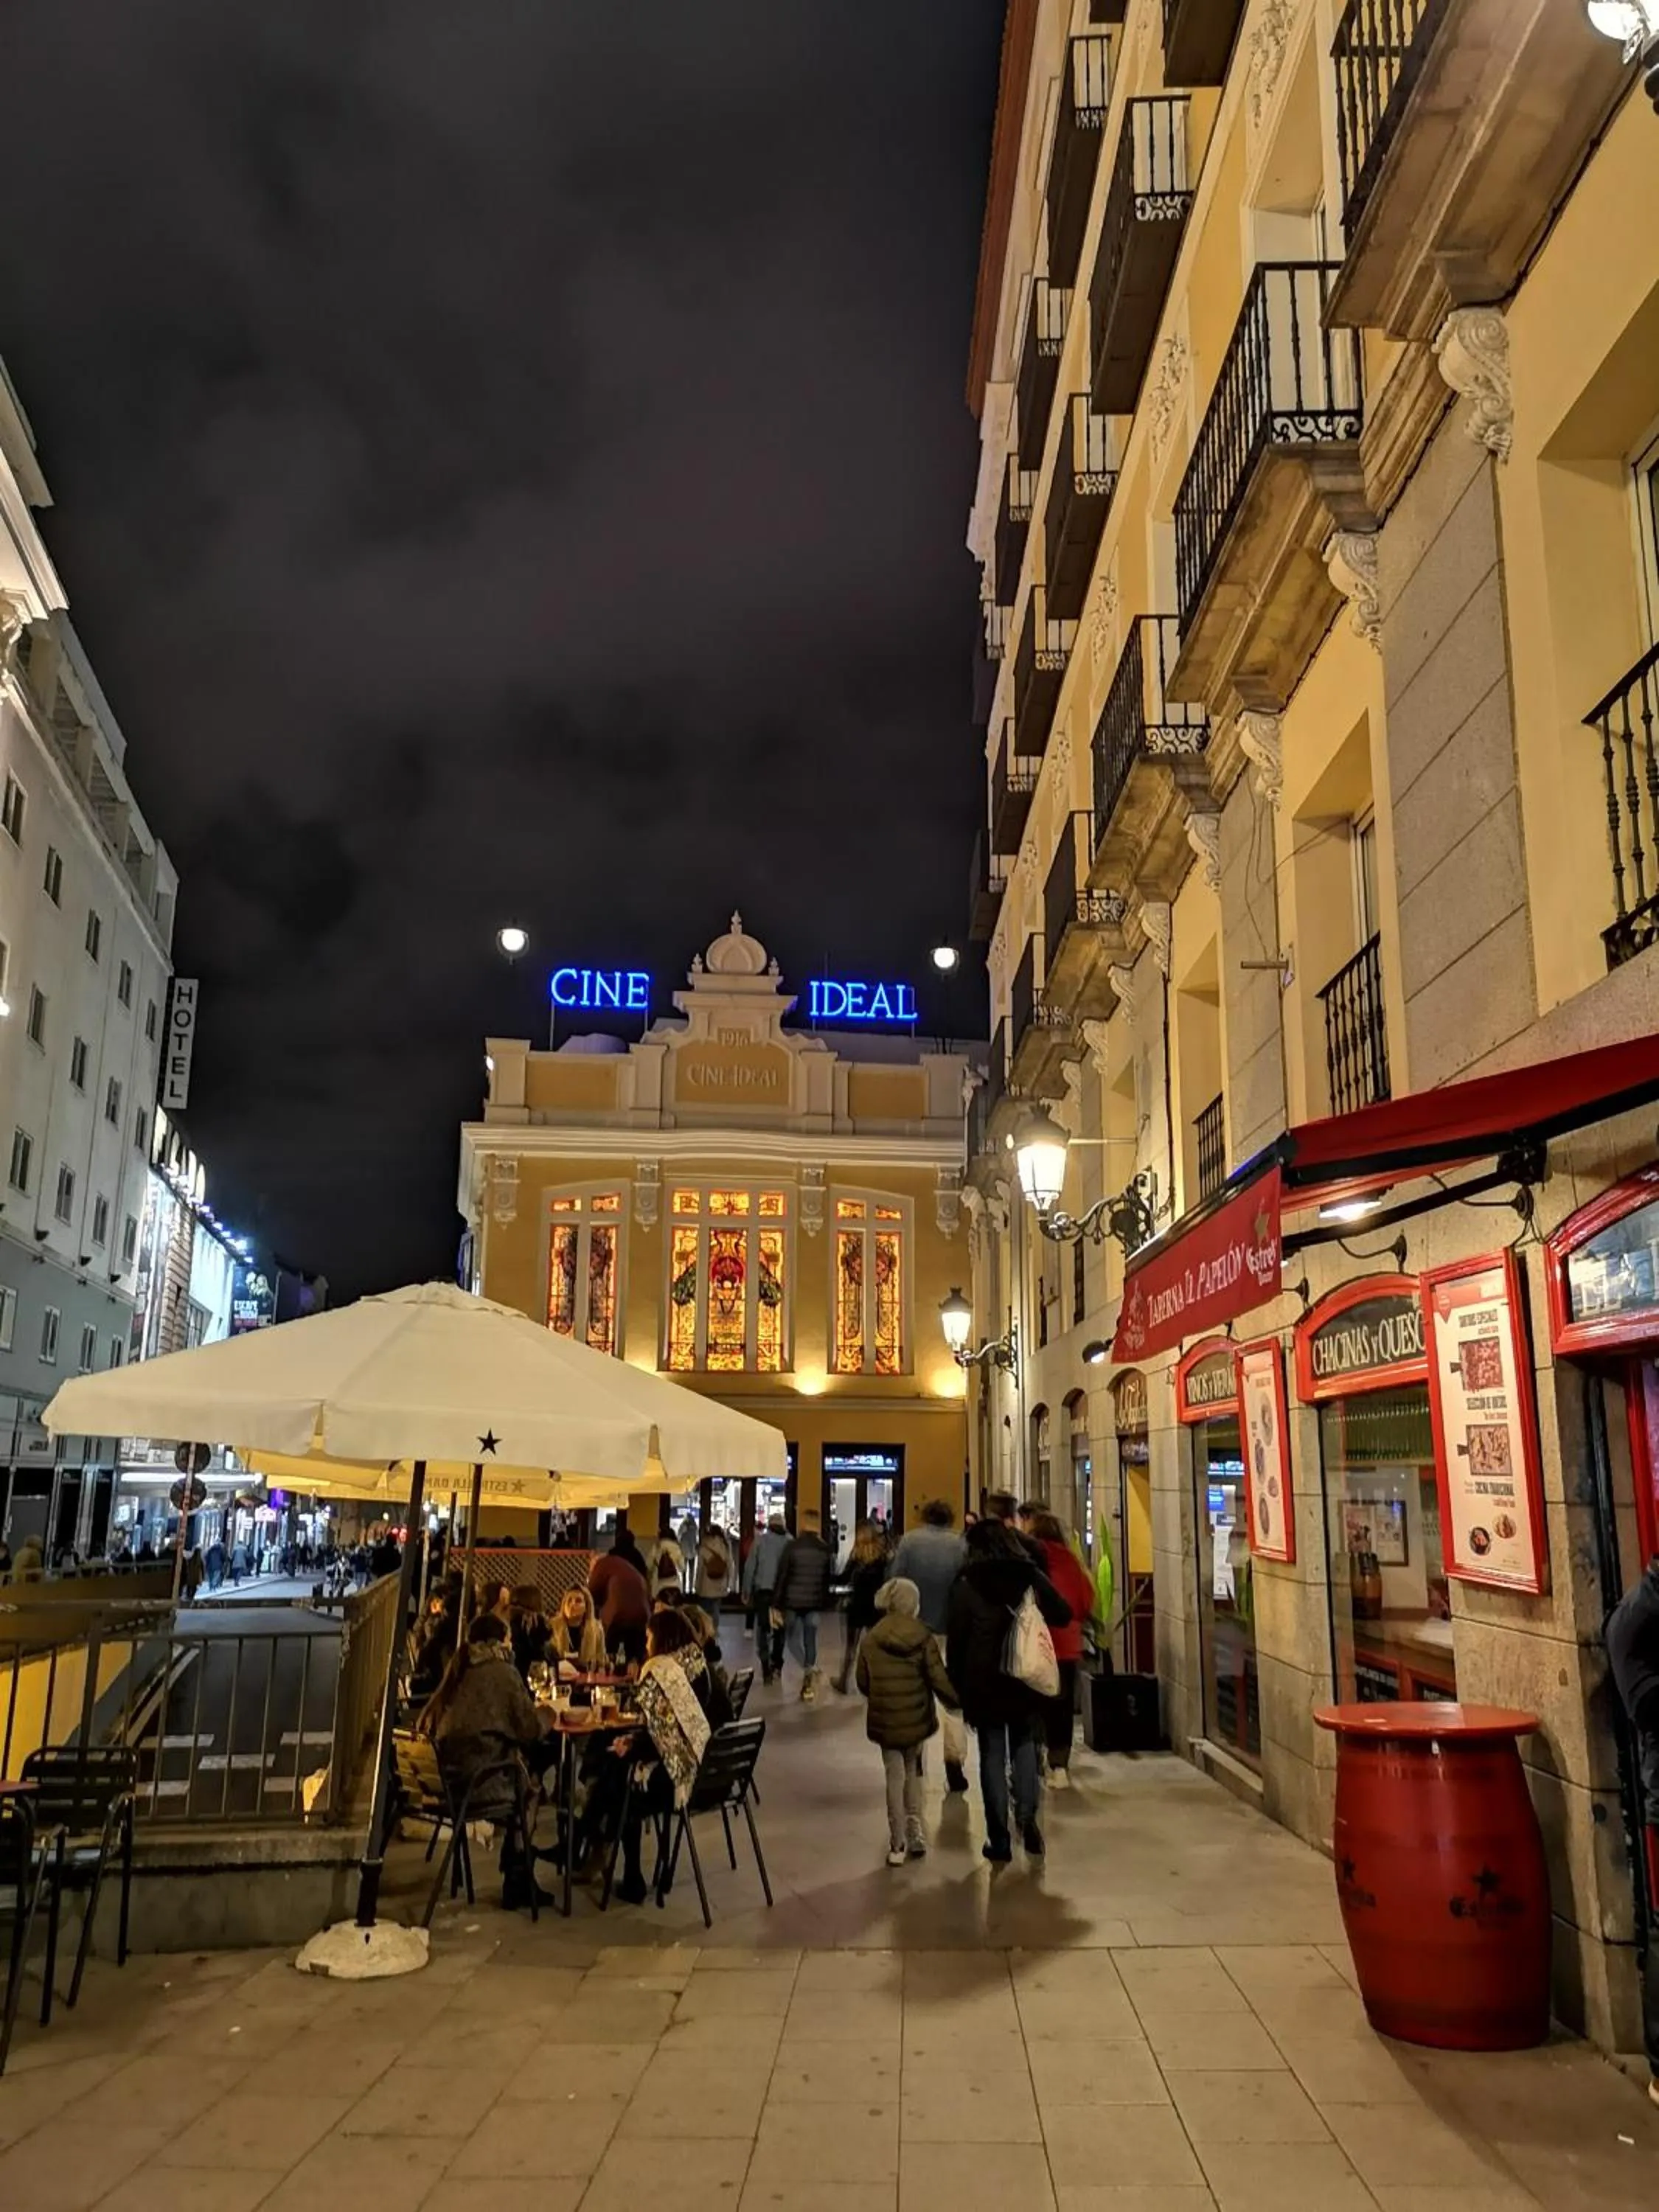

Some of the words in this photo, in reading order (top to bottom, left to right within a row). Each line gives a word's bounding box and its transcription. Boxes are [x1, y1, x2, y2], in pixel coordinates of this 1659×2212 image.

[551, 967, 650, 1007] CINE
[810, 980, 917, 1019] IDEAL
[170, 985, 192, 1098] HOTEL
[686, 1064, 728, 1087] CINE
[1147, 1282, 1185, 1328] TABERNA
[1312, 1324, 1371, 1376] CHACINAS
